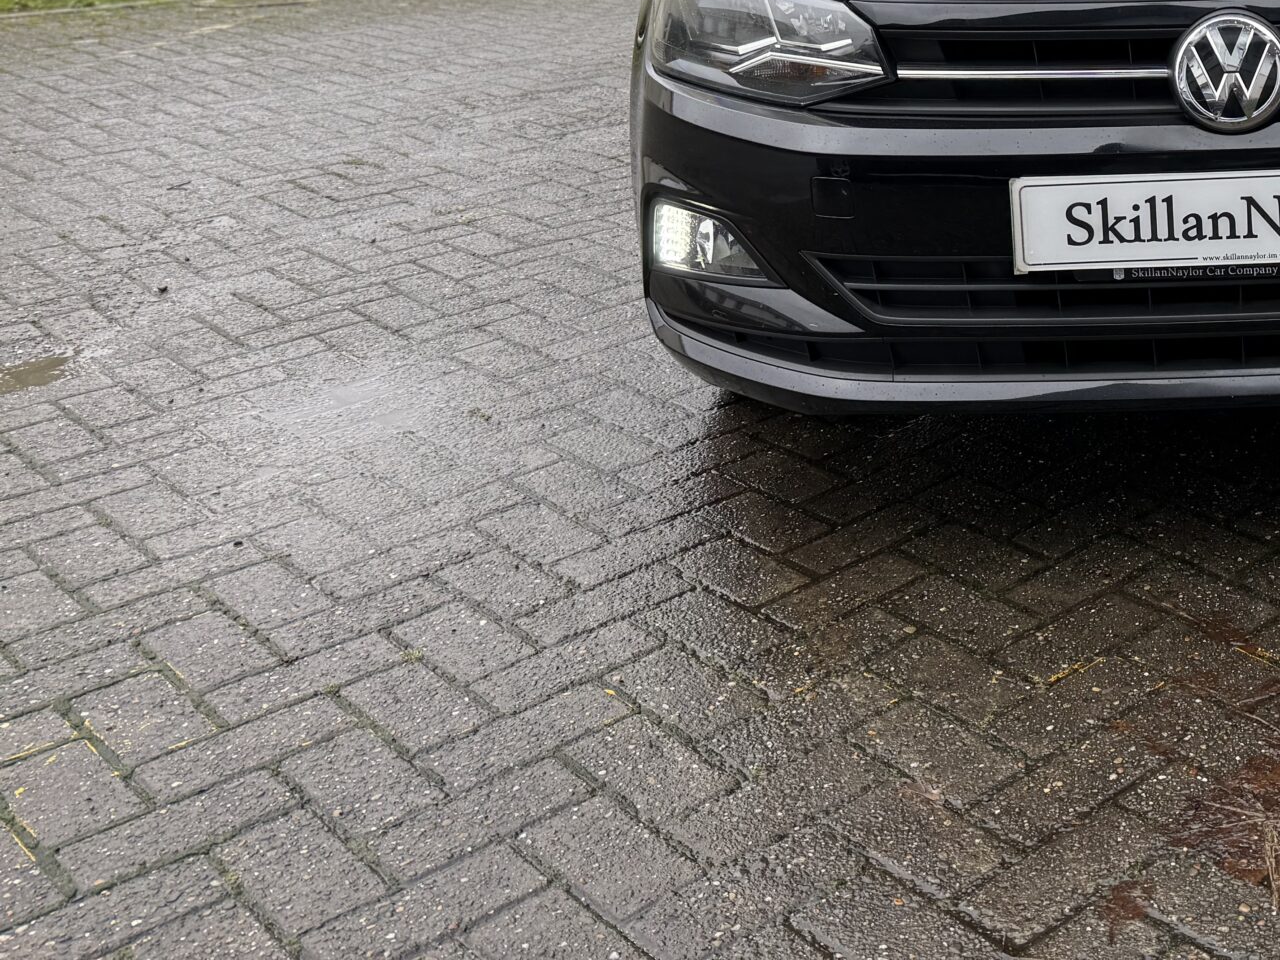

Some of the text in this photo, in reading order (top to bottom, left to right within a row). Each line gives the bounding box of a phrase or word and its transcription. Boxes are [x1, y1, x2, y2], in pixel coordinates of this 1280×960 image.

[1202, 253, 1278, 262] www.skillannaylor.im
[1131, 264, 1279, 278] SkillanNaylor Car Company
